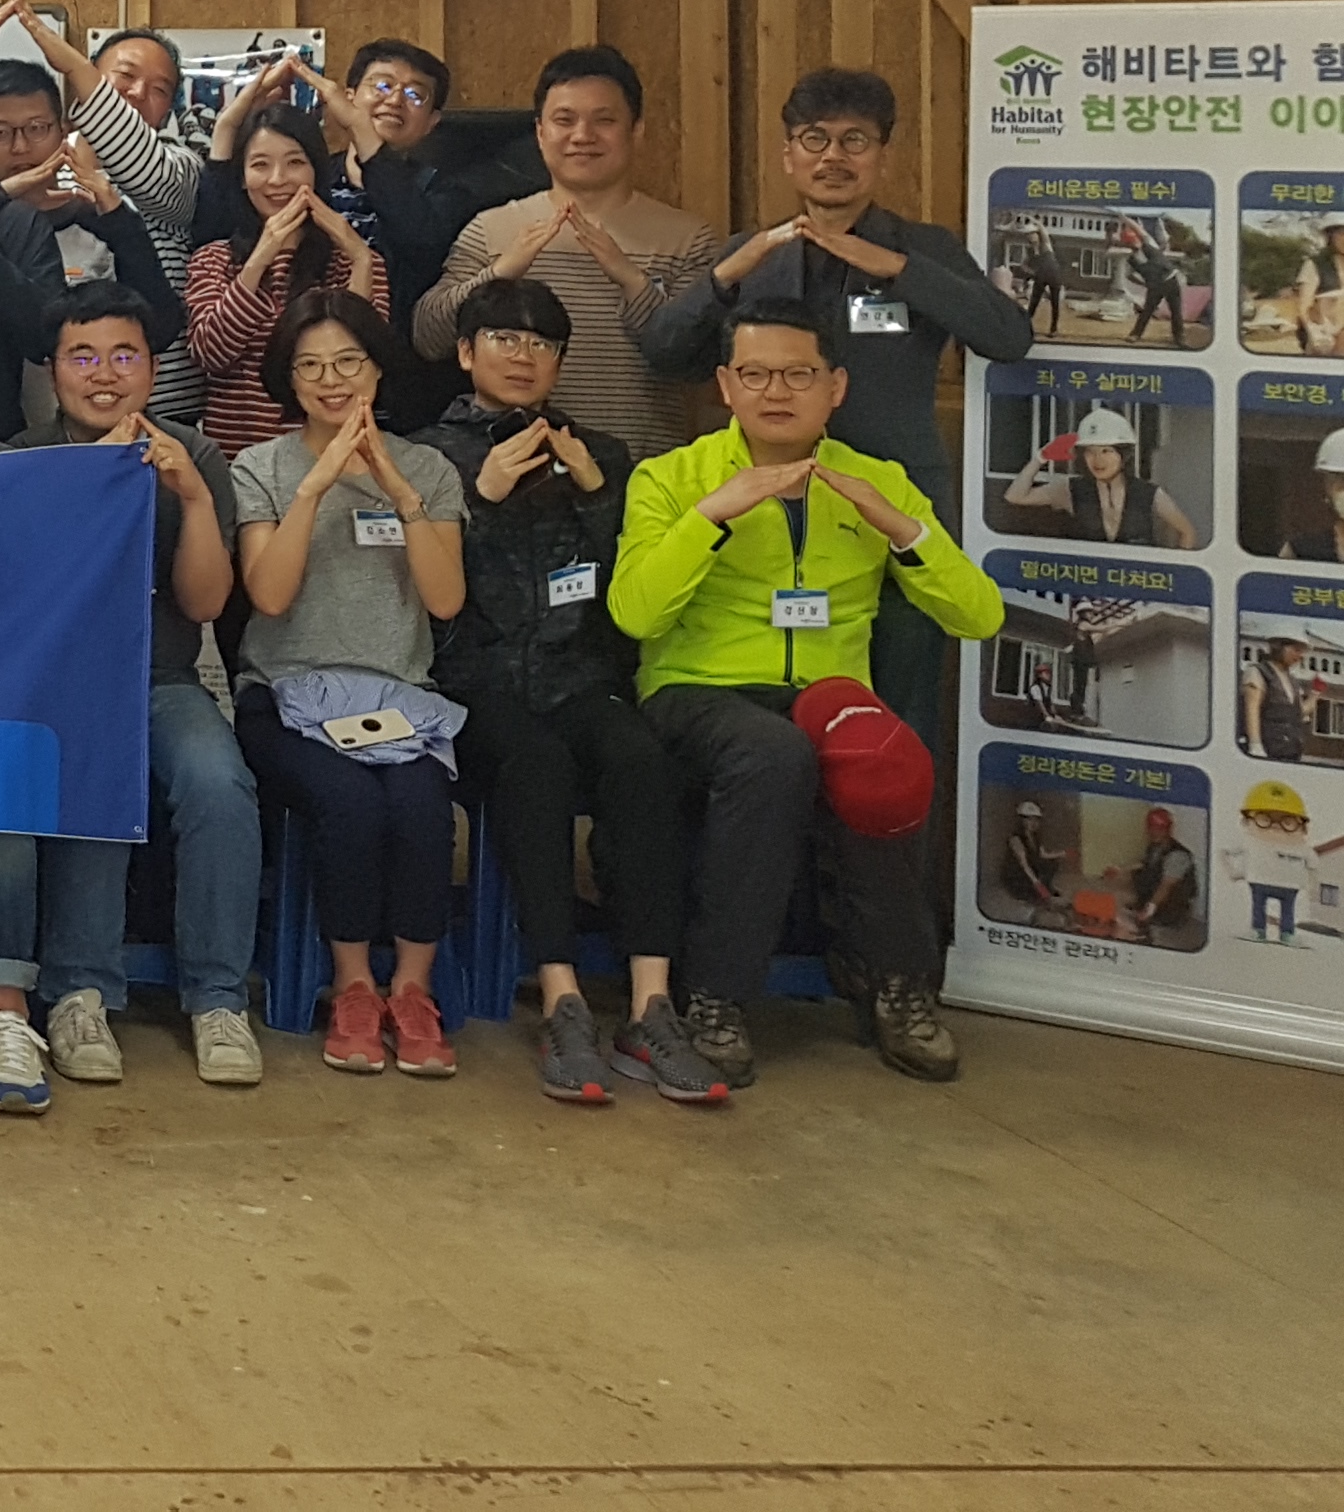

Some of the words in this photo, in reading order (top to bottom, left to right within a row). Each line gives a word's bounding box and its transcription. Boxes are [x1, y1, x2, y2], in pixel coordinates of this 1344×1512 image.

[1081, 43, 1287, 84] 해비타트와
[991, 106, 1063, 124] Habitat
[1081, 95, 1244, 135] 현장안전
[1026, 179, 1122, 200] 준비운동은
[1130, 181, 1176, 201] 필수!
[1068, 370, 1089, 390] 우
[1095, 372, 1163, 394] 살피기!
[1020, 560, 1099, 585] 떨어지면
[1107, 568, 1173, 592] 다쳐요!
[1017, 754, 1117, 784] 정리정돈은
[1124, 767, 1173, 791] 기본!
